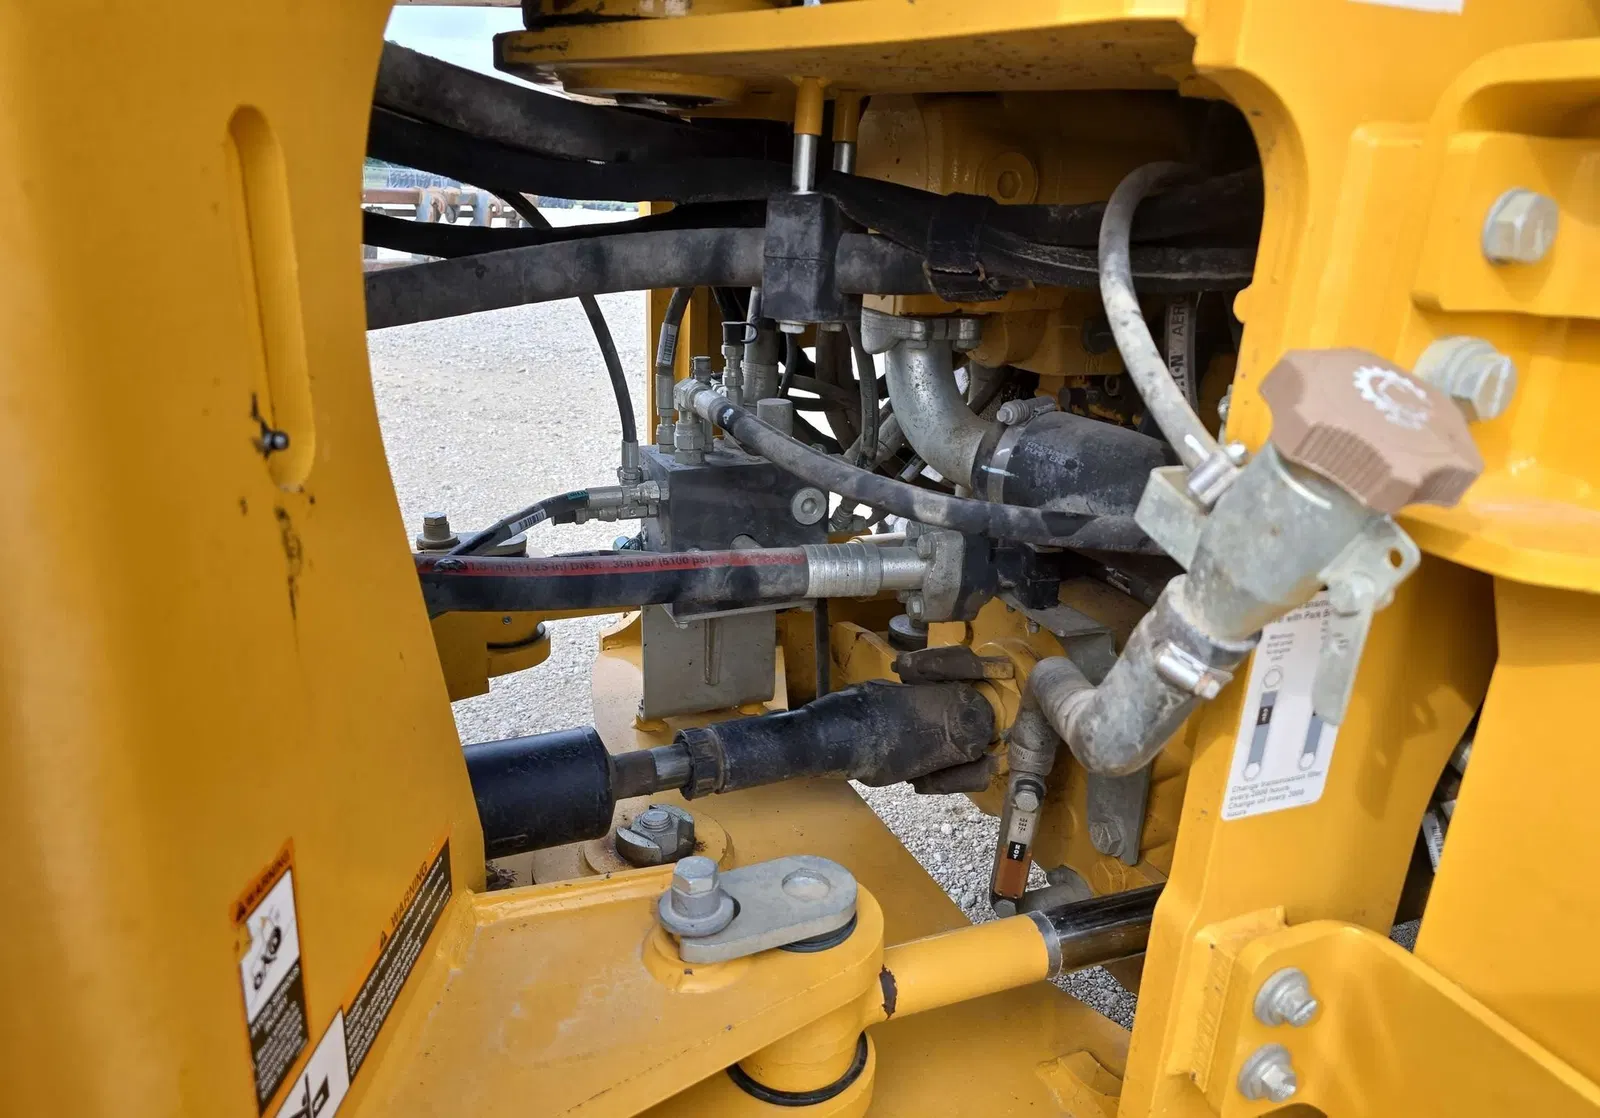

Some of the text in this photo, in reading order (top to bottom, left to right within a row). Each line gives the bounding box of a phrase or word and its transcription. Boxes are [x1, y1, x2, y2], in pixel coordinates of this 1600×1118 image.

[636, 558, 655, 567] bar
[692, 555, 713, 566] psi)
[390, 860, 428, 927] WARNING
